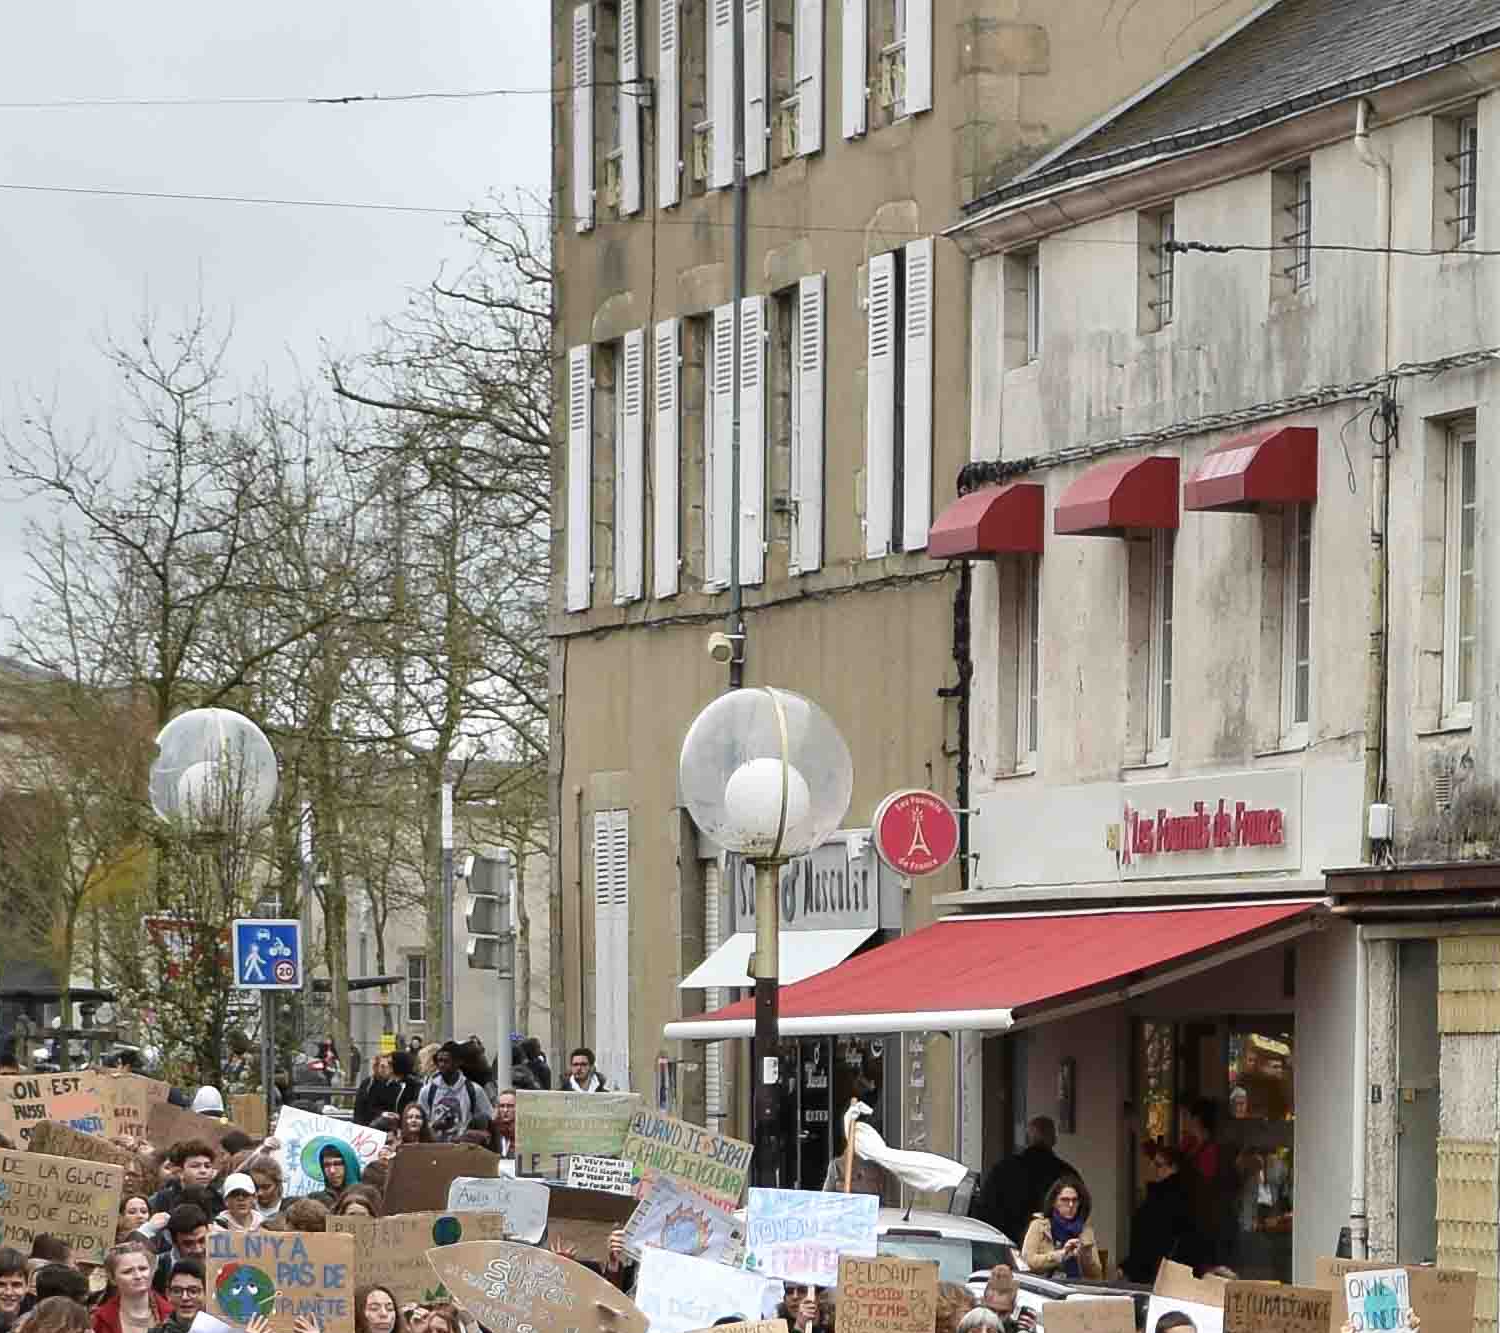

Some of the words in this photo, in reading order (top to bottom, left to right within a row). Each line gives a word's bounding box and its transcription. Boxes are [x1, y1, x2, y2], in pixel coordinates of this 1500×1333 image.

[13, 1080, 40, 1100] ON
[2, 1157, 25, 1175] DE
[38, 1163, 61, 1182] LA
[211, 1235, 238, 1260] IL
[277, 1262, 317, 1287] PAS
[323, 1264, 347, 1288] DE
